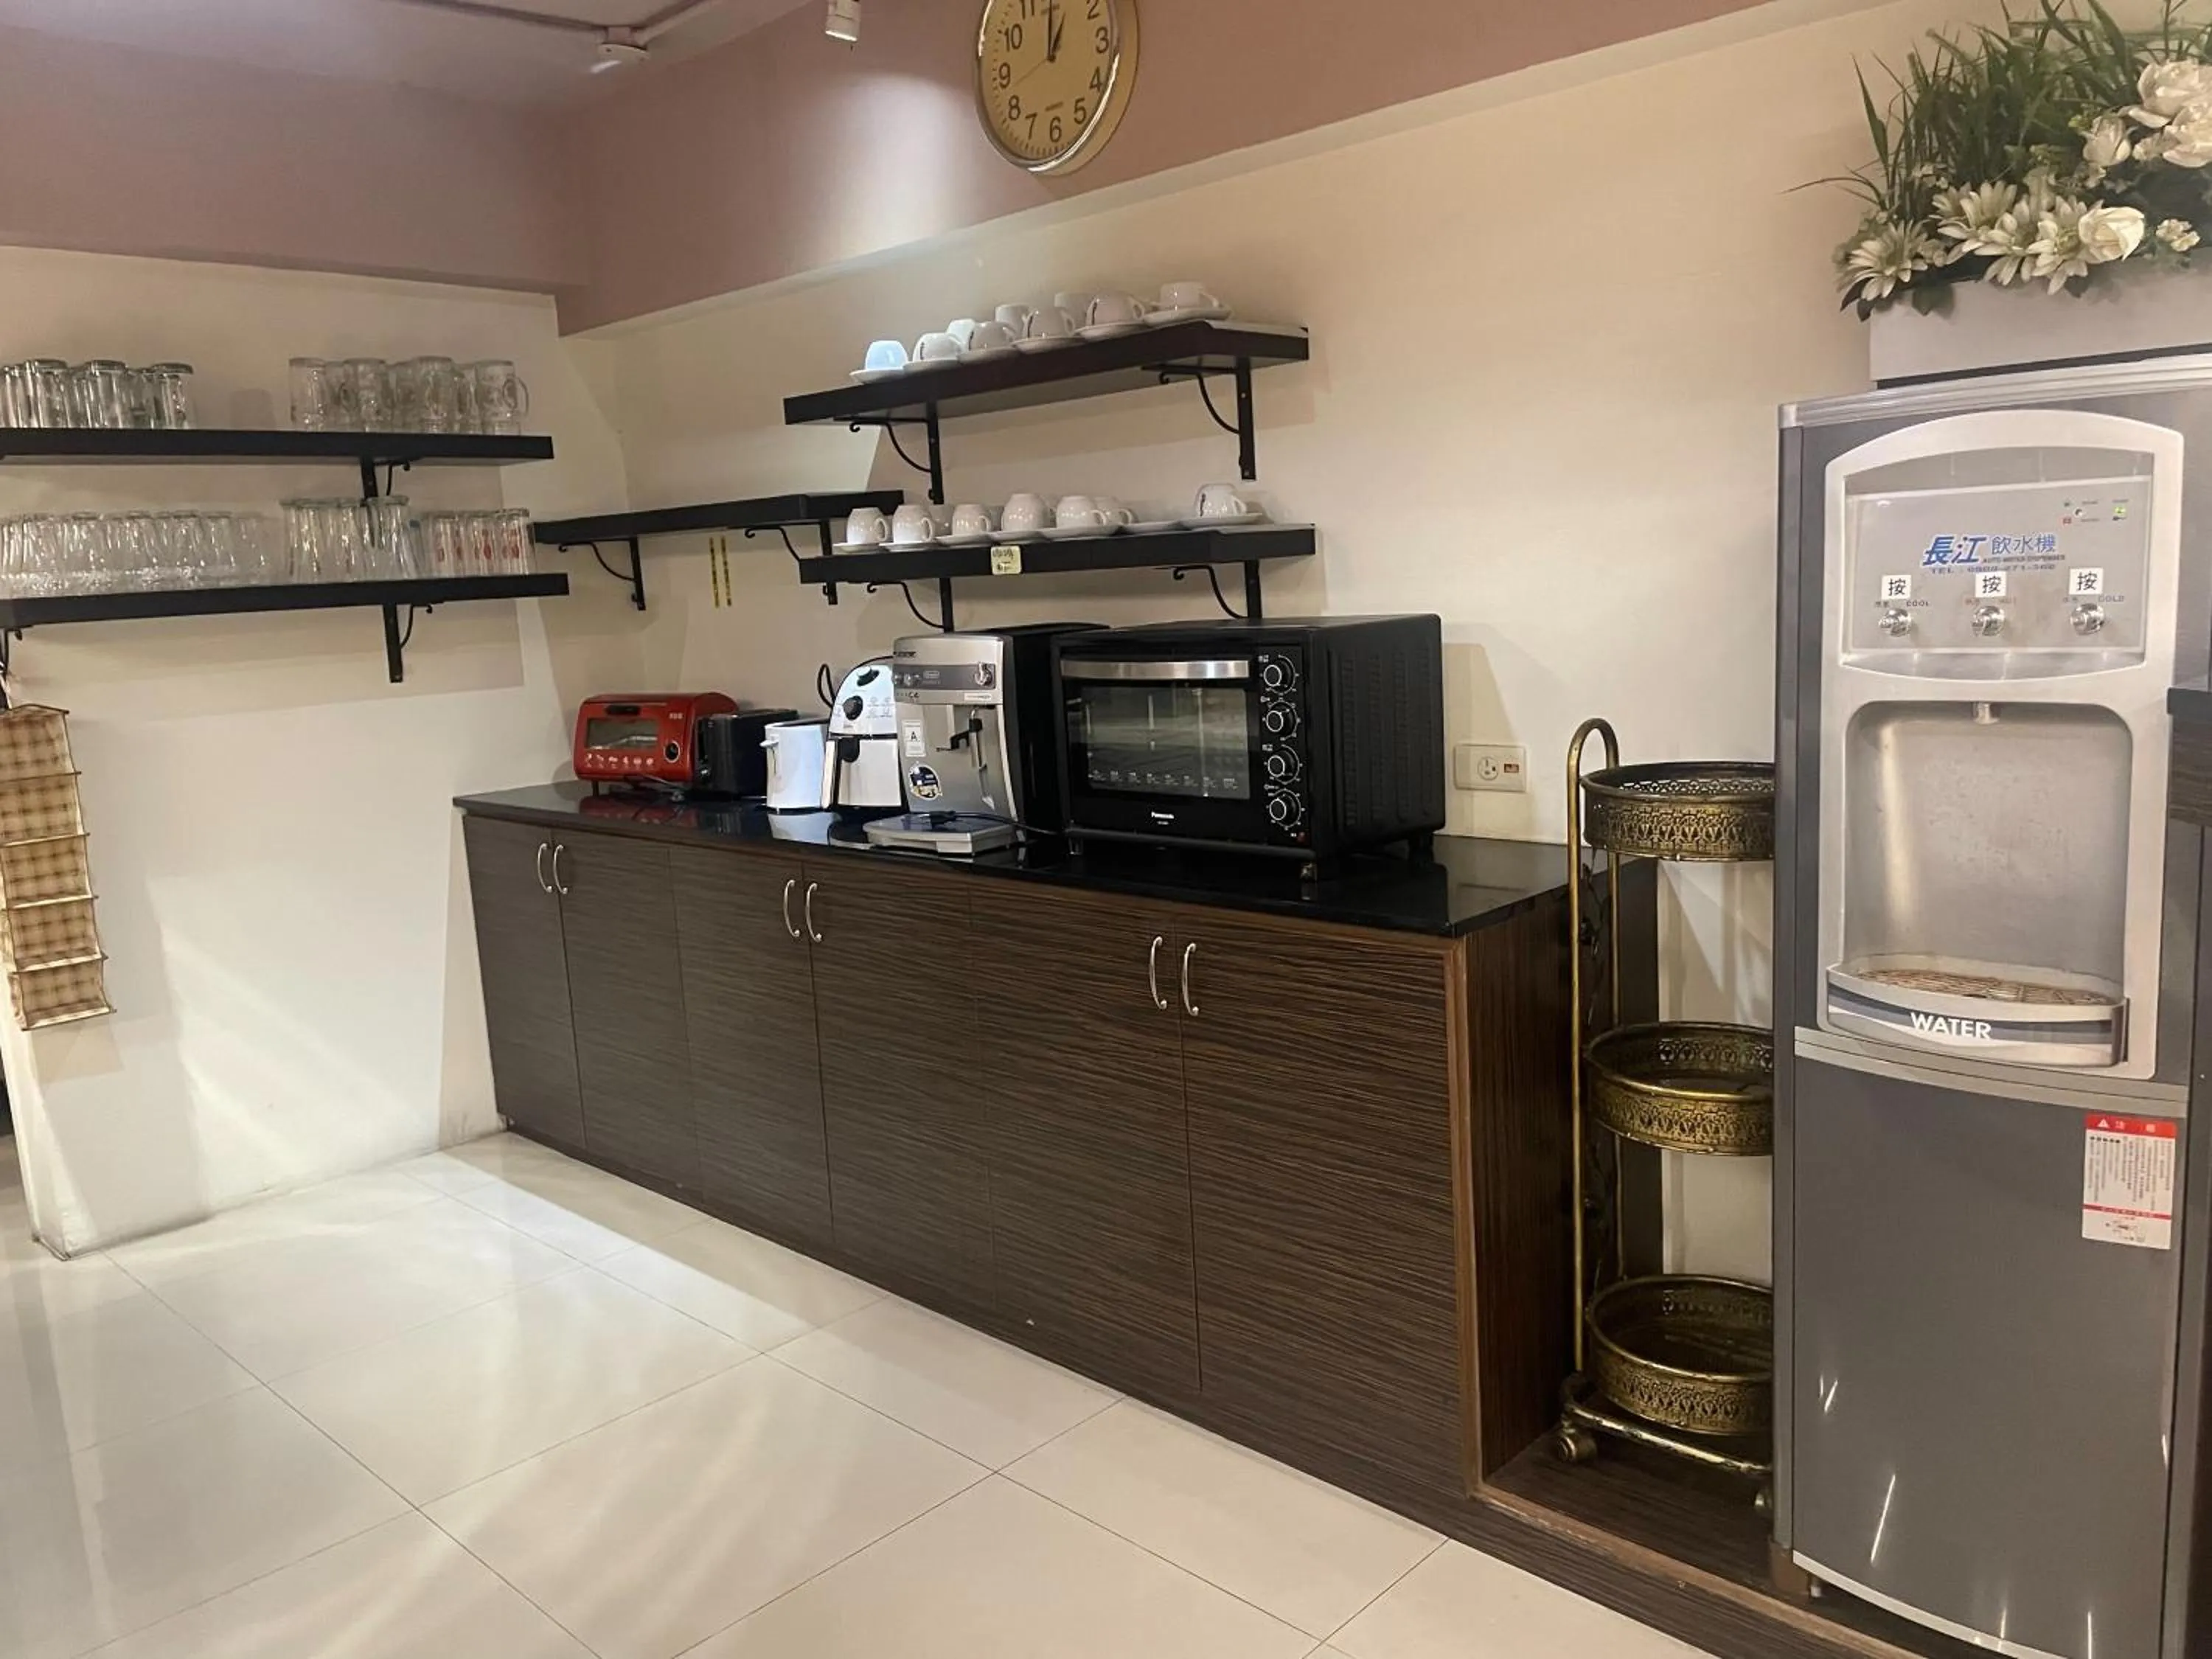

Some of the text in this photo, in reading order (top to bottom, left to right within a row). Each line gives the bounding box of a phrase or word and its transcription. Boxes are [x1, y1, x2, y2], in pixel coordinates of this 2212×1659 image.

[1086, 0, 1099, 20] 2
[1004, 24, 1023, 52] 10
[1096, 27, 1109, 54] 3
[998, 62, 1011, 88] 9
[1089, 66, 1103, 92] 4
[1008, 95, 1020, 120] 8
[1074, 97, 1087, 125] 5
[1025, 112, 1037, 140] 7
[1049, 116, 1062, 142] 6
[1922, 535, 2056, 566] 長江 飲水機
[1888, 578, 1906, 596] 按
[1982, 574, 2001, 594] 按
[2076, 571, 2098, 591] 按
[1910, 1012, 1992, 1039] WATER
